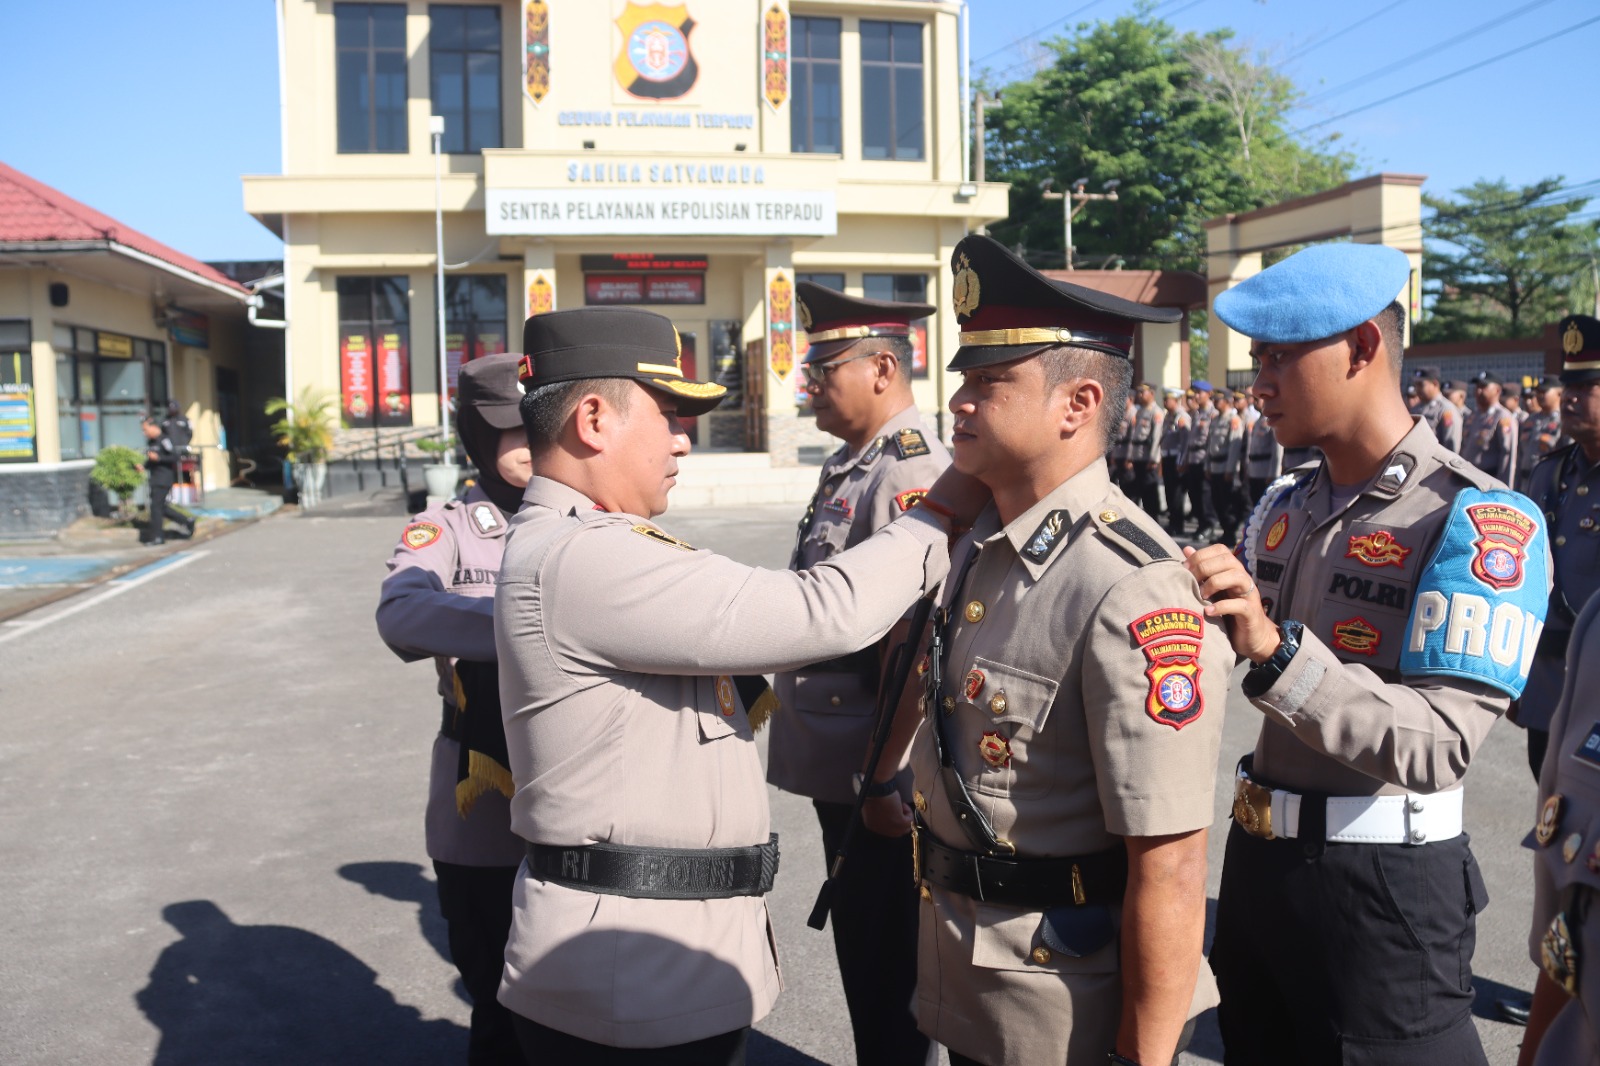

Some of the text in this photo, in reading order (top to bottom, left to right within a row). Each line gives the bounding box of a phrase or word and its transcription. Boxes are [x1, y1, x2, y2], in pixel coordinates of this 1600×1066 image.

[558, 111, 754, 130] GEDUNG PELAYANAN TERPADU
[649, 163, 766, 185] SATYAWADA
[499, 201, 823, 222] SENTRA PELAYANAN KEPOLISIAN TERPADU
[1477, 508, 1531, 525] POLRES
[1329, 572, 1408, 609] POLRI
[1145, 612, 1194, 629] POLRES
